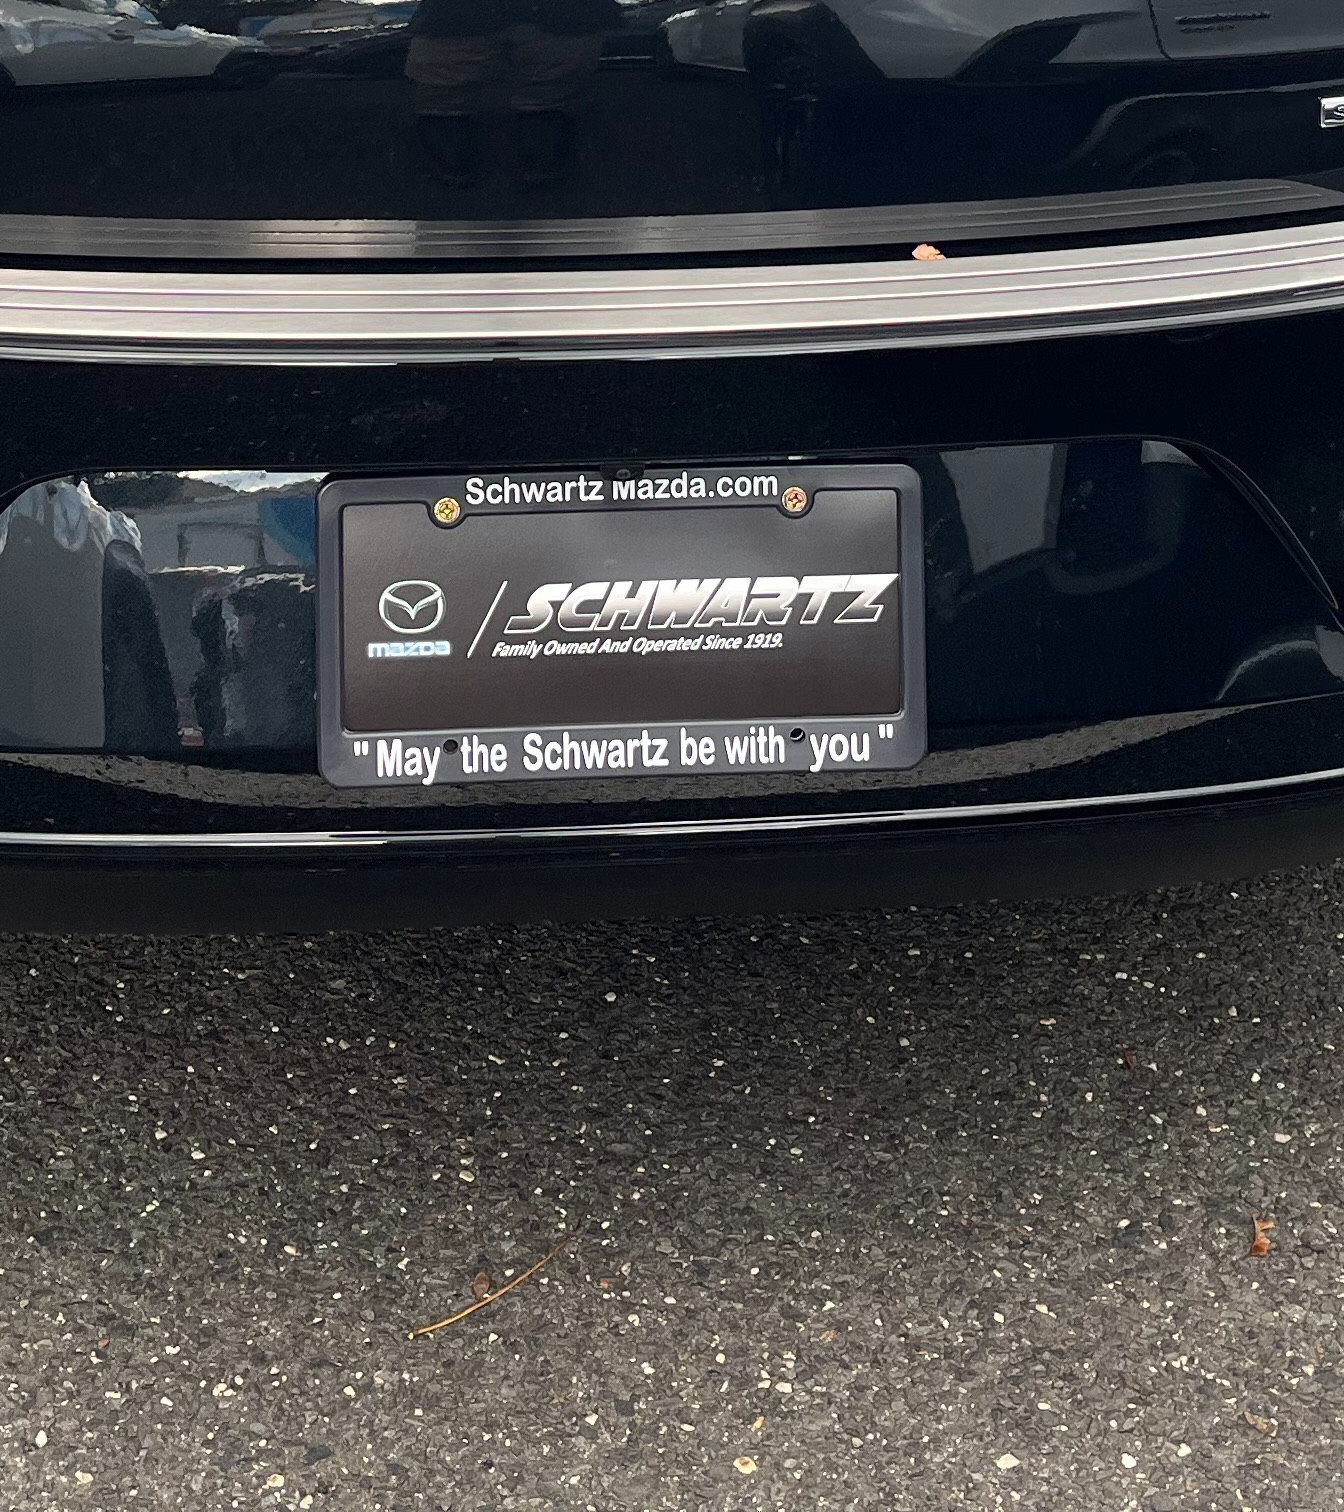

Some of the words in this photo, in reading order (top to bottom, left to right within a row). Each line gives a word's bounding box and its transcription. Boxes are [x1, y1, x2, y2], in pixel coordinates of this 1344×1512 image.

[465, 474, 605, 505] Schwartz
[612, 471, 778, 501] Mazda.com
[503, 573, 900, 634] SCHWARTZ
[367, 640, 452, 659] mazda
[491, 639, 543, 660] Family
[544, 638, 597, 656] Owned
[599, 637, 631, 654] And
[632, 635, 700, 655] Operated
[701, 633, 742, 651] Since
[743, 632, 784, 649] 1919.
[376, 738, 441, 786] May
[460, 734, 508, 774] the
[522, 731, 670, 772] Schwartz
[679, 726, 716, 766] be
[723, 724, 786, 765] with
[809, 732, 871, 773] you
